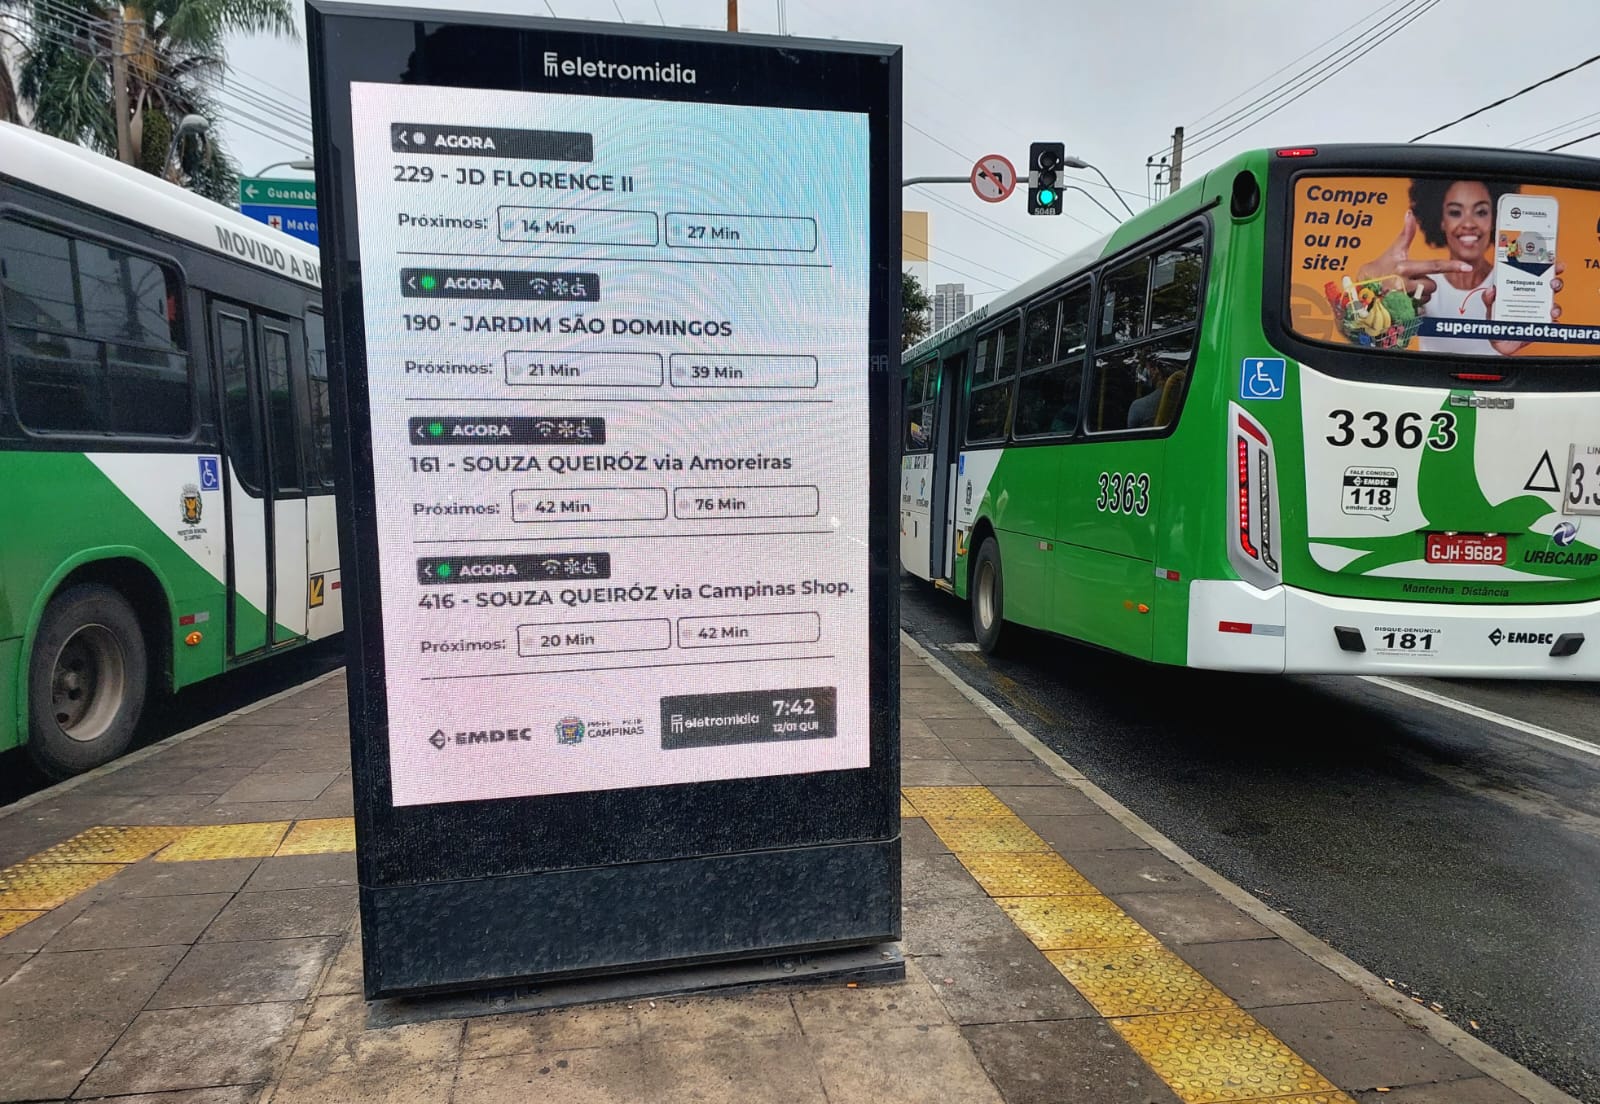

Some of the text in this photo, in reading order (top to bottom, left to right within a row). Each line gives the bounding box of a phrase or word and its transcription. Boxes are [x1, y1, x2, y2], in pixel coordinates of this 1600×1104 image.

[561, 56, 697, 84] eletromidia
[434, 134, 496, 150] AGORA
[393, 165, 434, 183] 229
[455, 168, 486, 186] JD
[493, 169, 615, 192] FLORENCE
[621, 175, 635, 193] II
[1306, 184, 1388, 206] Compre
[398, 212, 740, 241] Próximos: 14 Min 27 Min
[1304, 208, 1373, 231] na loja
[215, 224, 286, 271] MOVIDO
[290, 254, 302, 277] A
[1304, 233, 1361, 250] ou no
[1302, 254, 1348, 273] site!
[444, 277, 504, 292] AGORA
[403, 314, 441, 332] 190
[463, 315, 551, 334] JARDIM
[559, 313, 605, 335] SÃO
[612, 318, 733, 337] DOMINGOS
[405, 359, 743, 380] Próximos: 21 Min 39 Min
[452, 423, 511, 437] AGORA
[1326, 408, 1458, 450] 3363
[410, 456, 440, 473] 161
[463, 455, 541, 473] SOUZA
[548, 451, 648, 475] QUEIRÓZ
[653, 454, 684, 471] via
[689, 453, 793, 471] Amoreiras
[1363, 478, 1390, 486] EMDEC
[1097, 472, 1151, 517] 3363
[1350, 488, 1391, 506] 118
[413, 497, 746, 517] Próximos: 42 Min 76 Min
[1524, 549, 1599, 566] URBCAMP
[459, 562, 518, 577] AGORA
[418, 593, 455, 610] 416
[475, 590, 553, 608] SOUZA
[560, 584, 658, 606] QUEIRÓZ
[663, 584, 693, 602] via
[699, 582, 796, 602] Campinas
[801, 579, 854, 598] Shop.
[1402, 583, 1510, 597] Mantenha Distância
[421, 625, 749, 655] Próximos: 20 Min 42 Min
[1382, 633, 1433, 650] 181
[1508, 632, 1553, 645] EMDEC
[772, 698, 816, 716] 7:42
[684, 713, 760, 729] eletromidia
[799, 721, 819, 732] QUI
[455, 727, 532, 745] EMDEC
[588, 726, 645, 738] CAMPINAS
